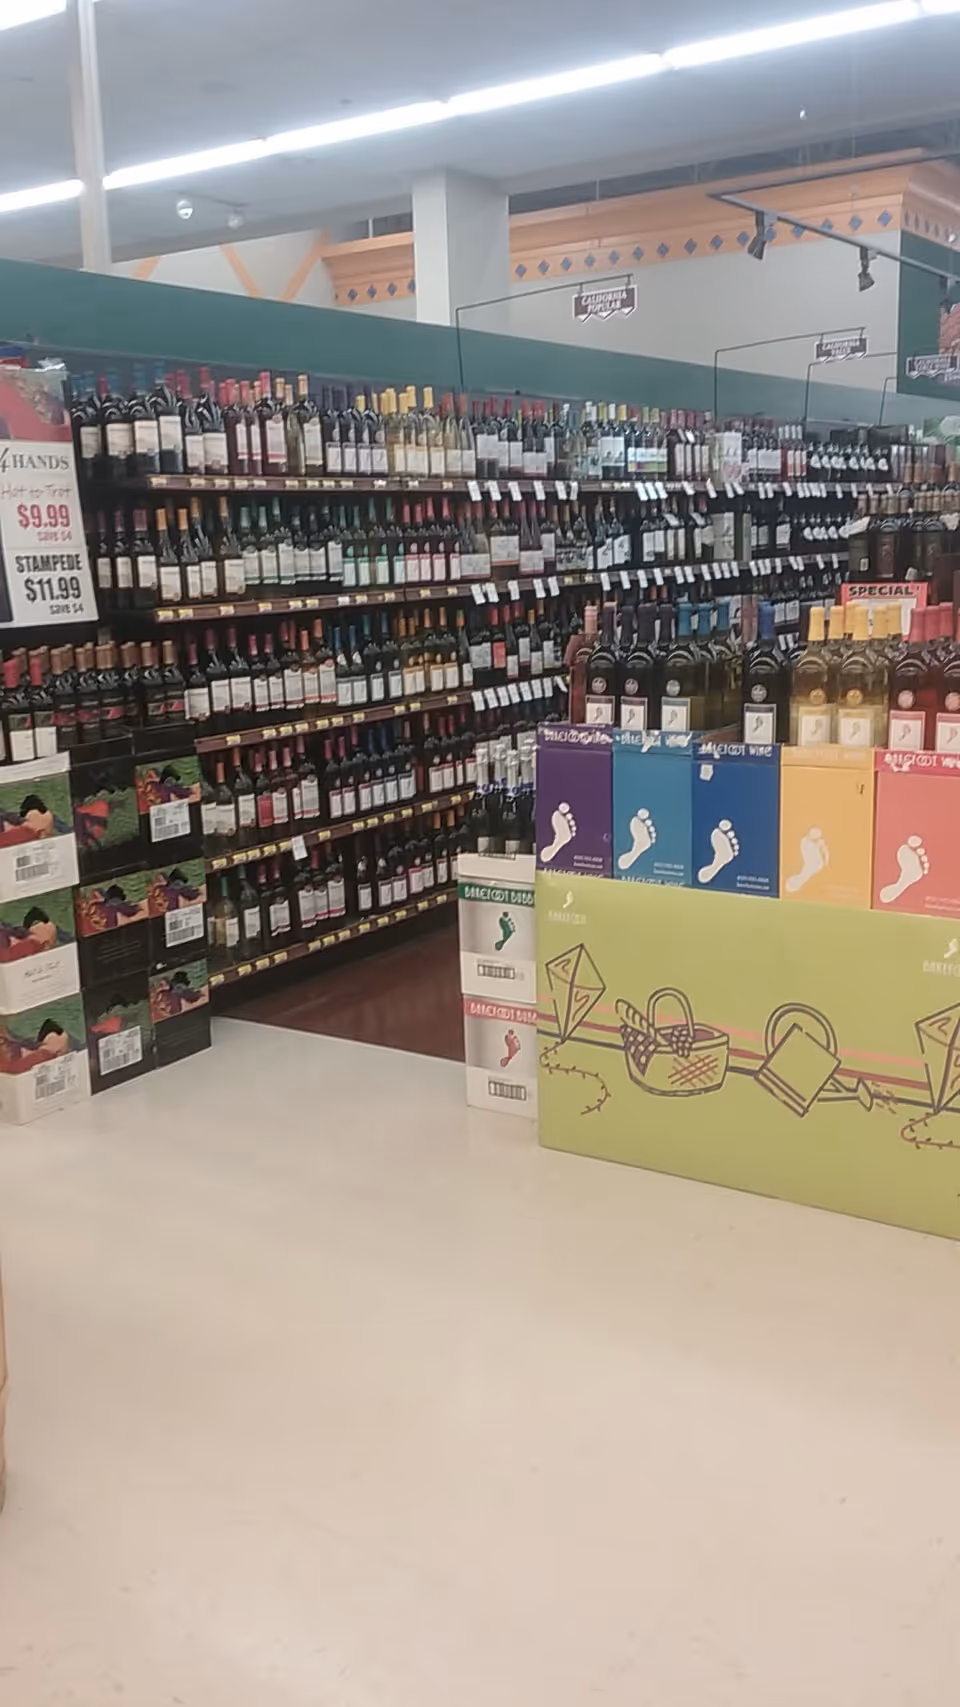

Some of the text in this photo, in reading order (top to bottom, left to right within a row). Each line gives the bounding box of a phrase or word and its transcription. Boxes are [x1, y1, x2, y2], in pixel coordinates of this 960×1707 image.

[12, 454, 70, 471] HANDS
[17, 503, 71, 530] $9.99
[15, 554, 82, 573] STAMPEDE
[24, 576, 82, 603] $11.99
